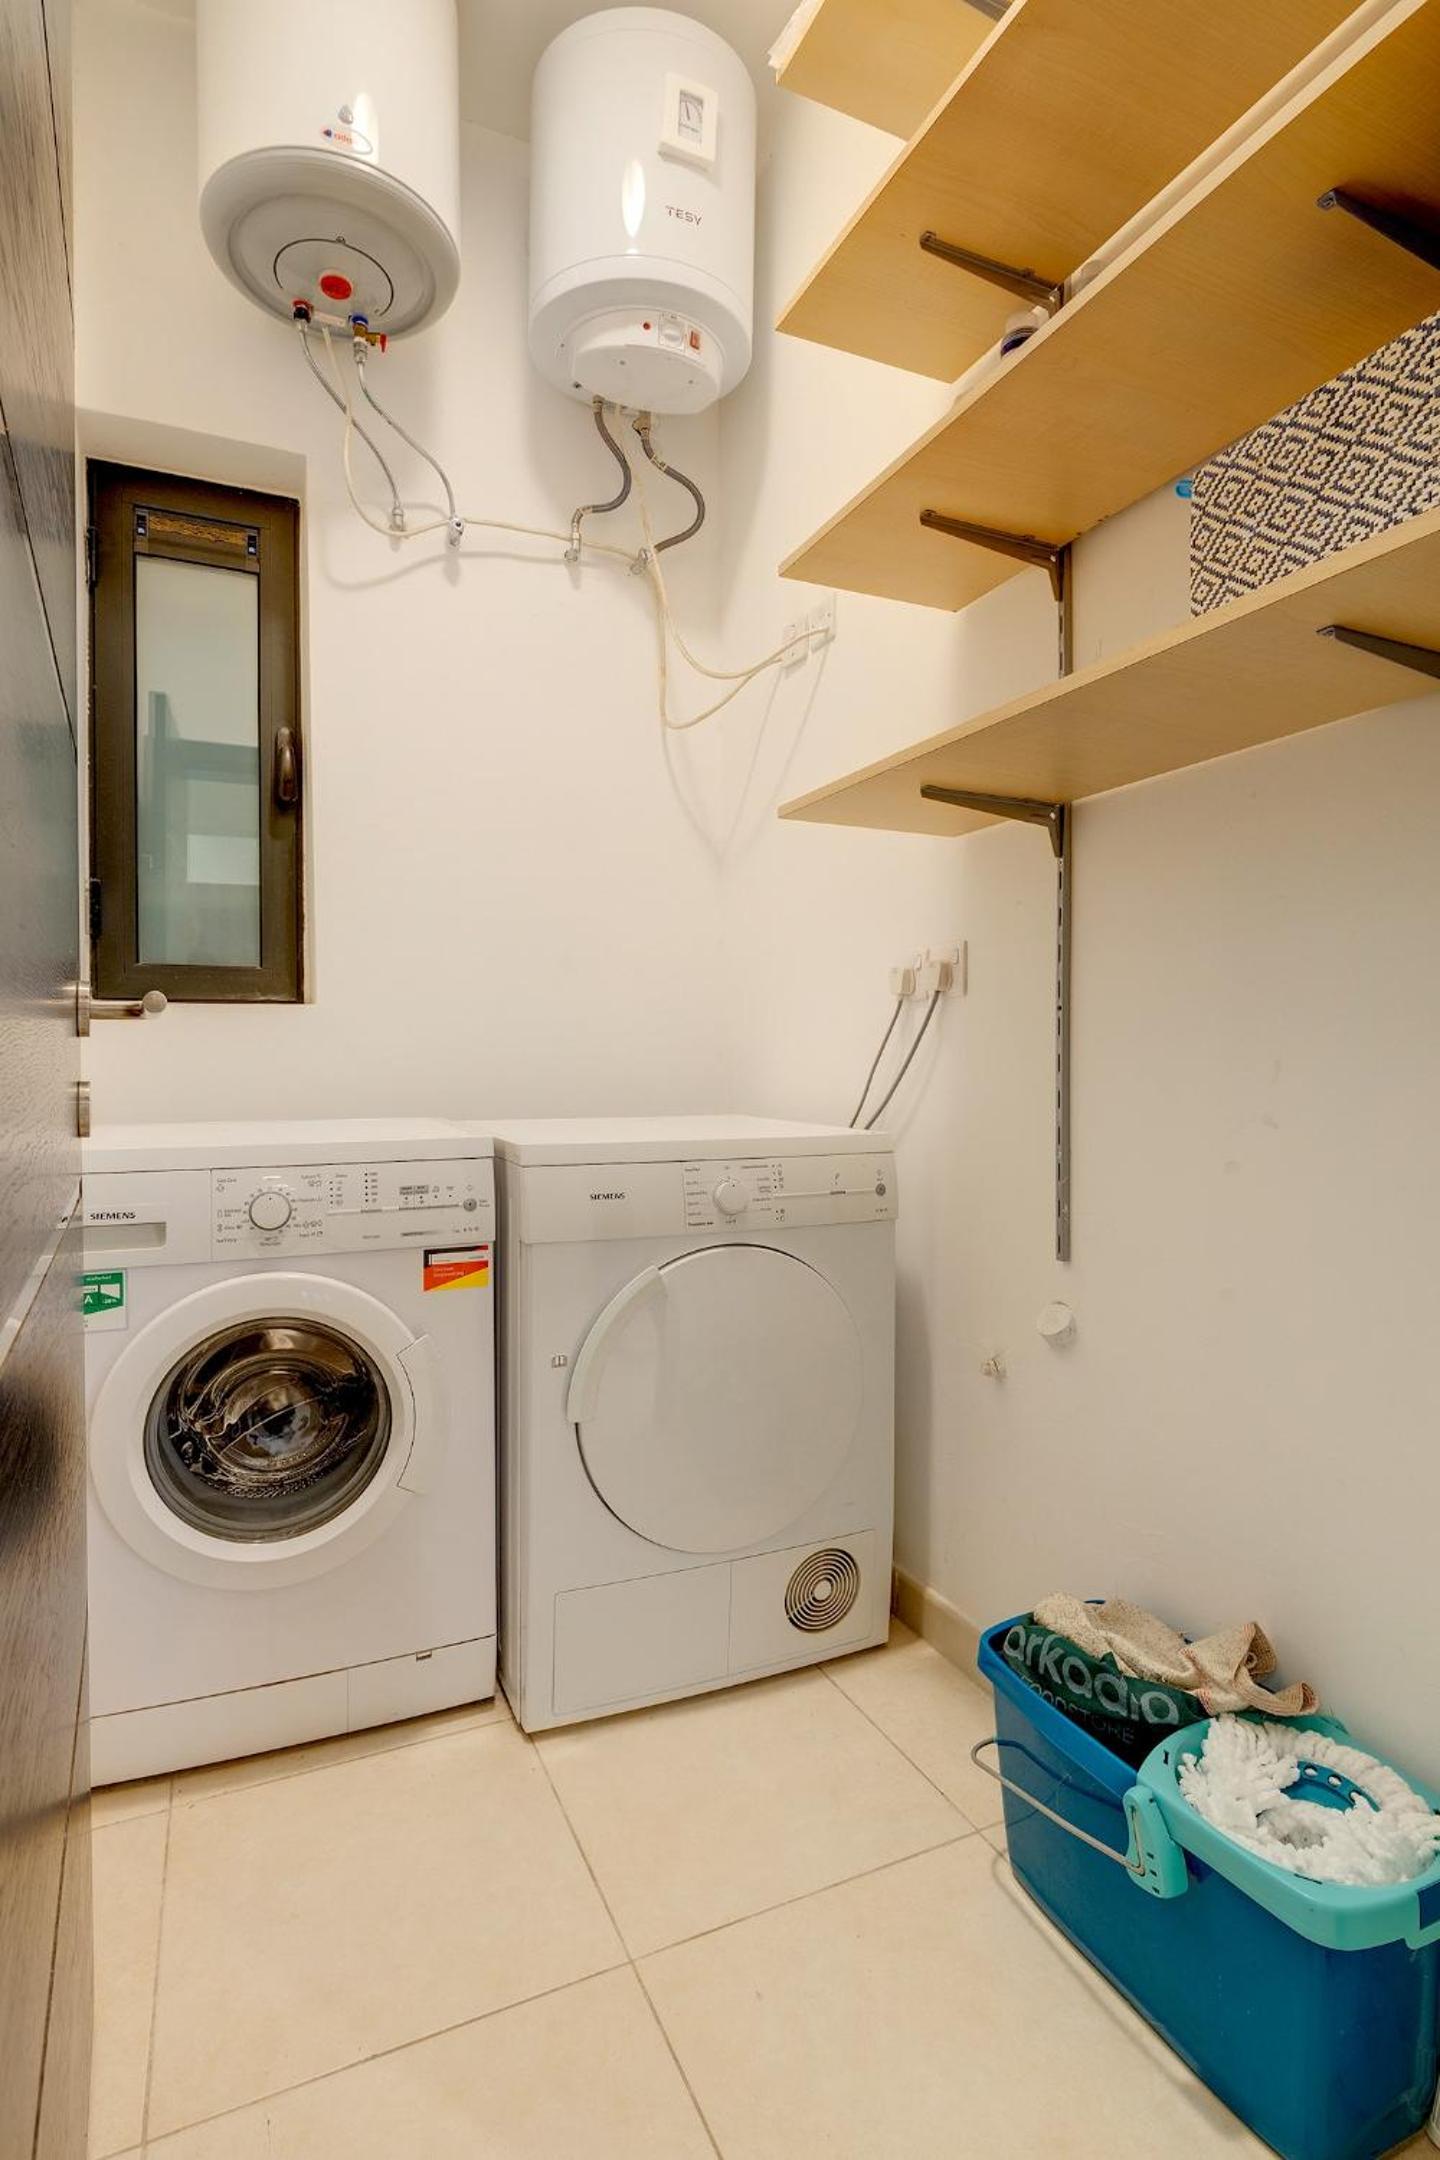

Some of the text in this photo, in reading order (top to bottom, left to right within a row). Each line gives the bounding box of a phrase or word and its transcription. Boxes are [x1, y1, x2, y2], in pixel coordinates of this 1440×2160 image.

[665, 204, 702, 226] TESY
[590, 1192, 626, 1200] SIEMENS
[89, 1211, 136, 1221] SIEMENS
[84, 1295, 93, 1305] A
